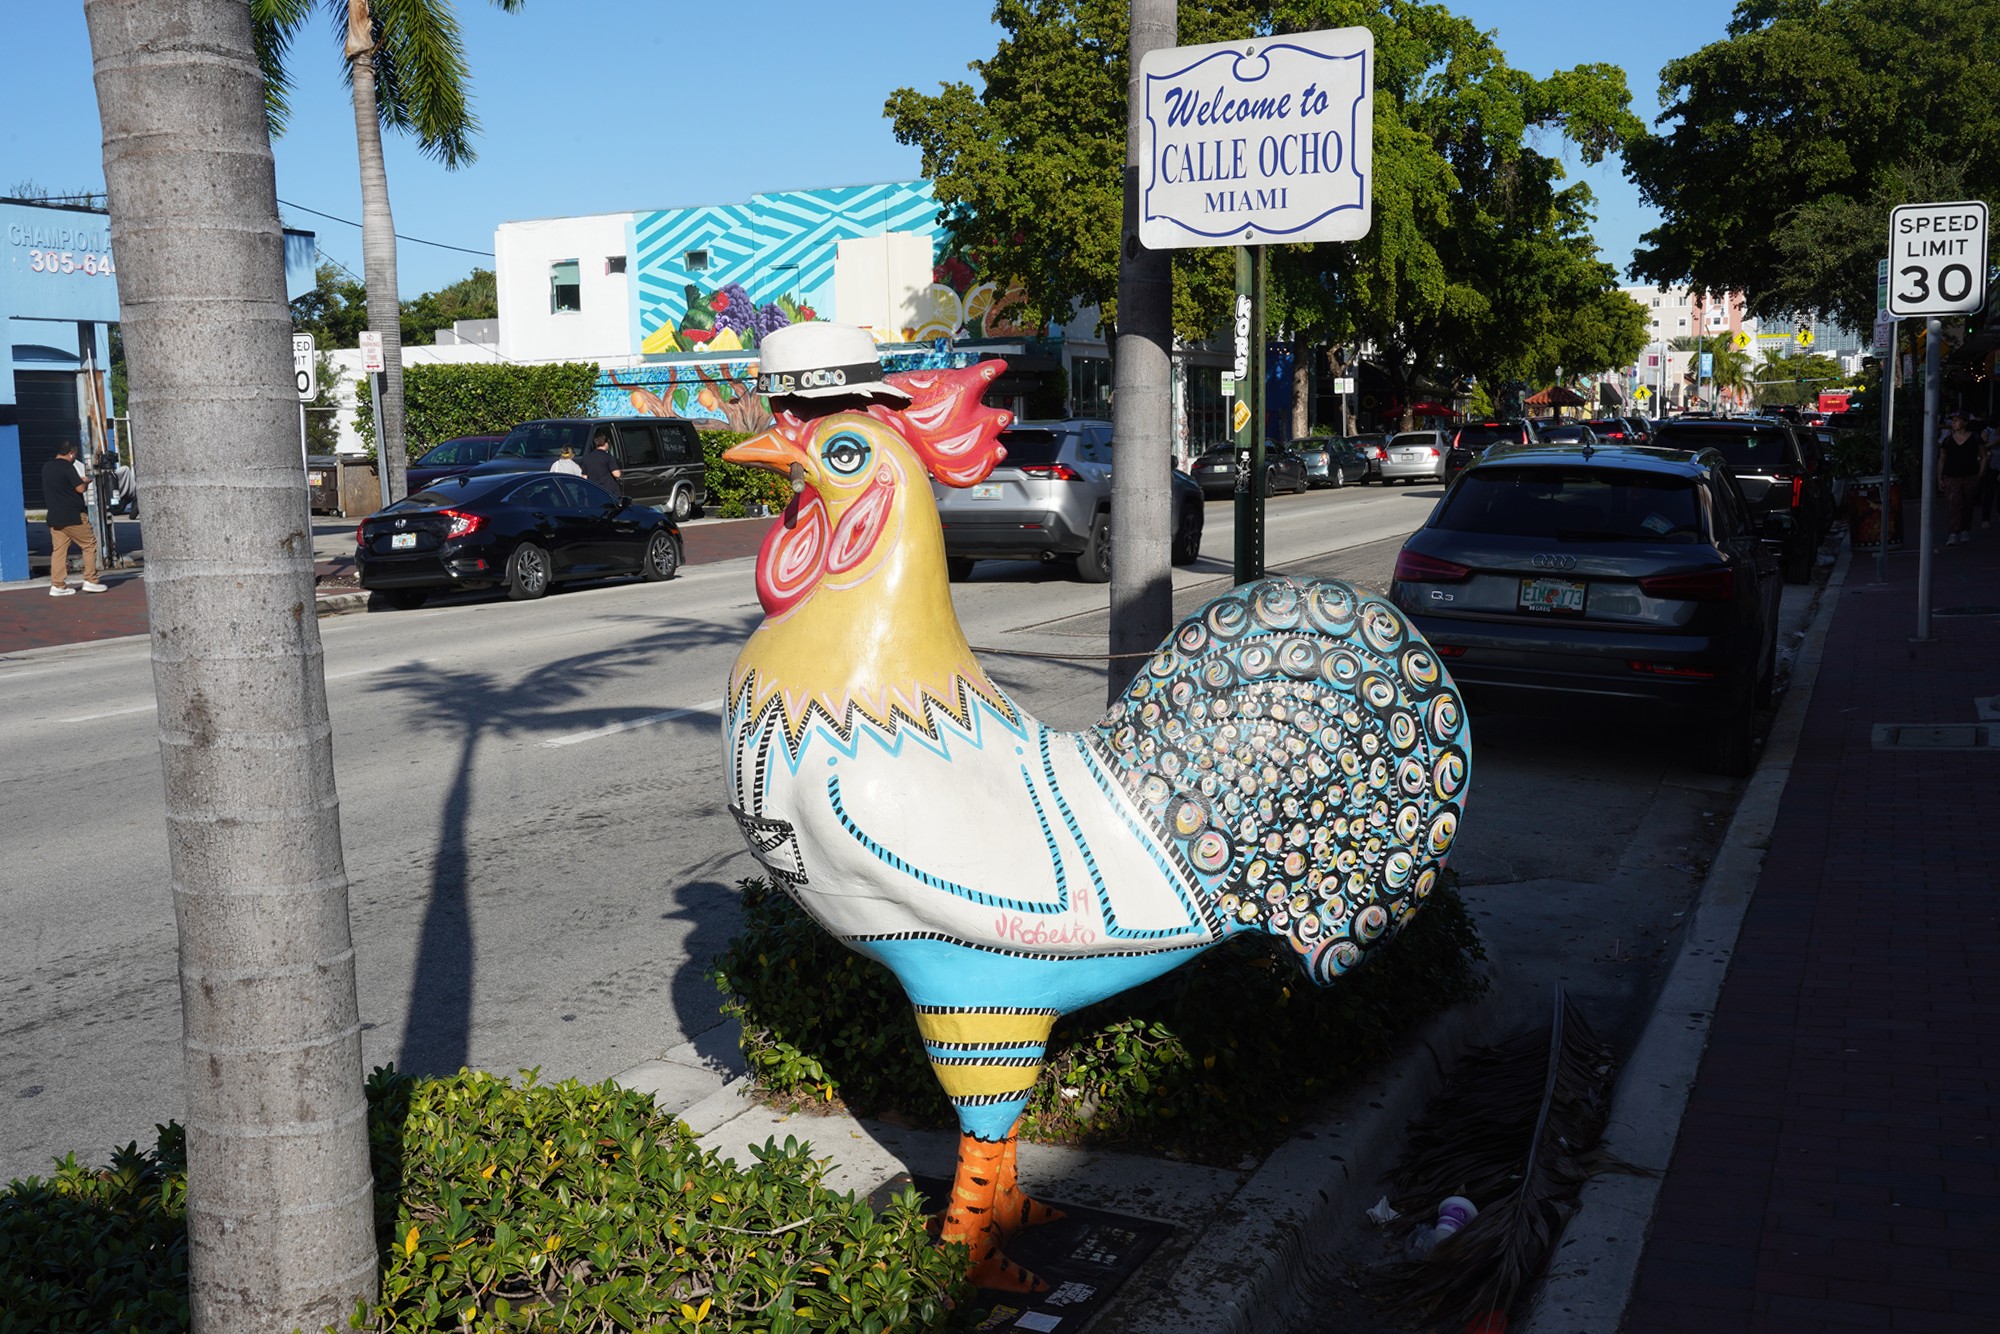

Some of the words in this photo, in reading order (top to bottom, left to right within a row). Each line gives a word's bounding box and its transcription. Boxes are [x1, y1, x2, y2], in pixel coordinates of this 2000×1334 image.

[1164, 85, 1291, 128] Welcome
[1299, 82, 1330, 118] to
[1161, 138, 1248, 184] CALLE
[1258, 130, 1343, 178] OCHO
[1204, 187, 1289, 214] MIAMI
[9, 223, 101, 253] CHAMPION
[1899, 214, 1979, 234] SPEED
[29, 249, 117, 276] 305-64
[1907, 239, 1969, 258] LIMIT
[1897, 263, 1973, 304] 30
[1234, 294, 1252, 382] KORS
[800, 368, 847, 389] OCHO
[1431, 590, 1455, 602] Q3
[1072, 888, 1090, 917] 19
